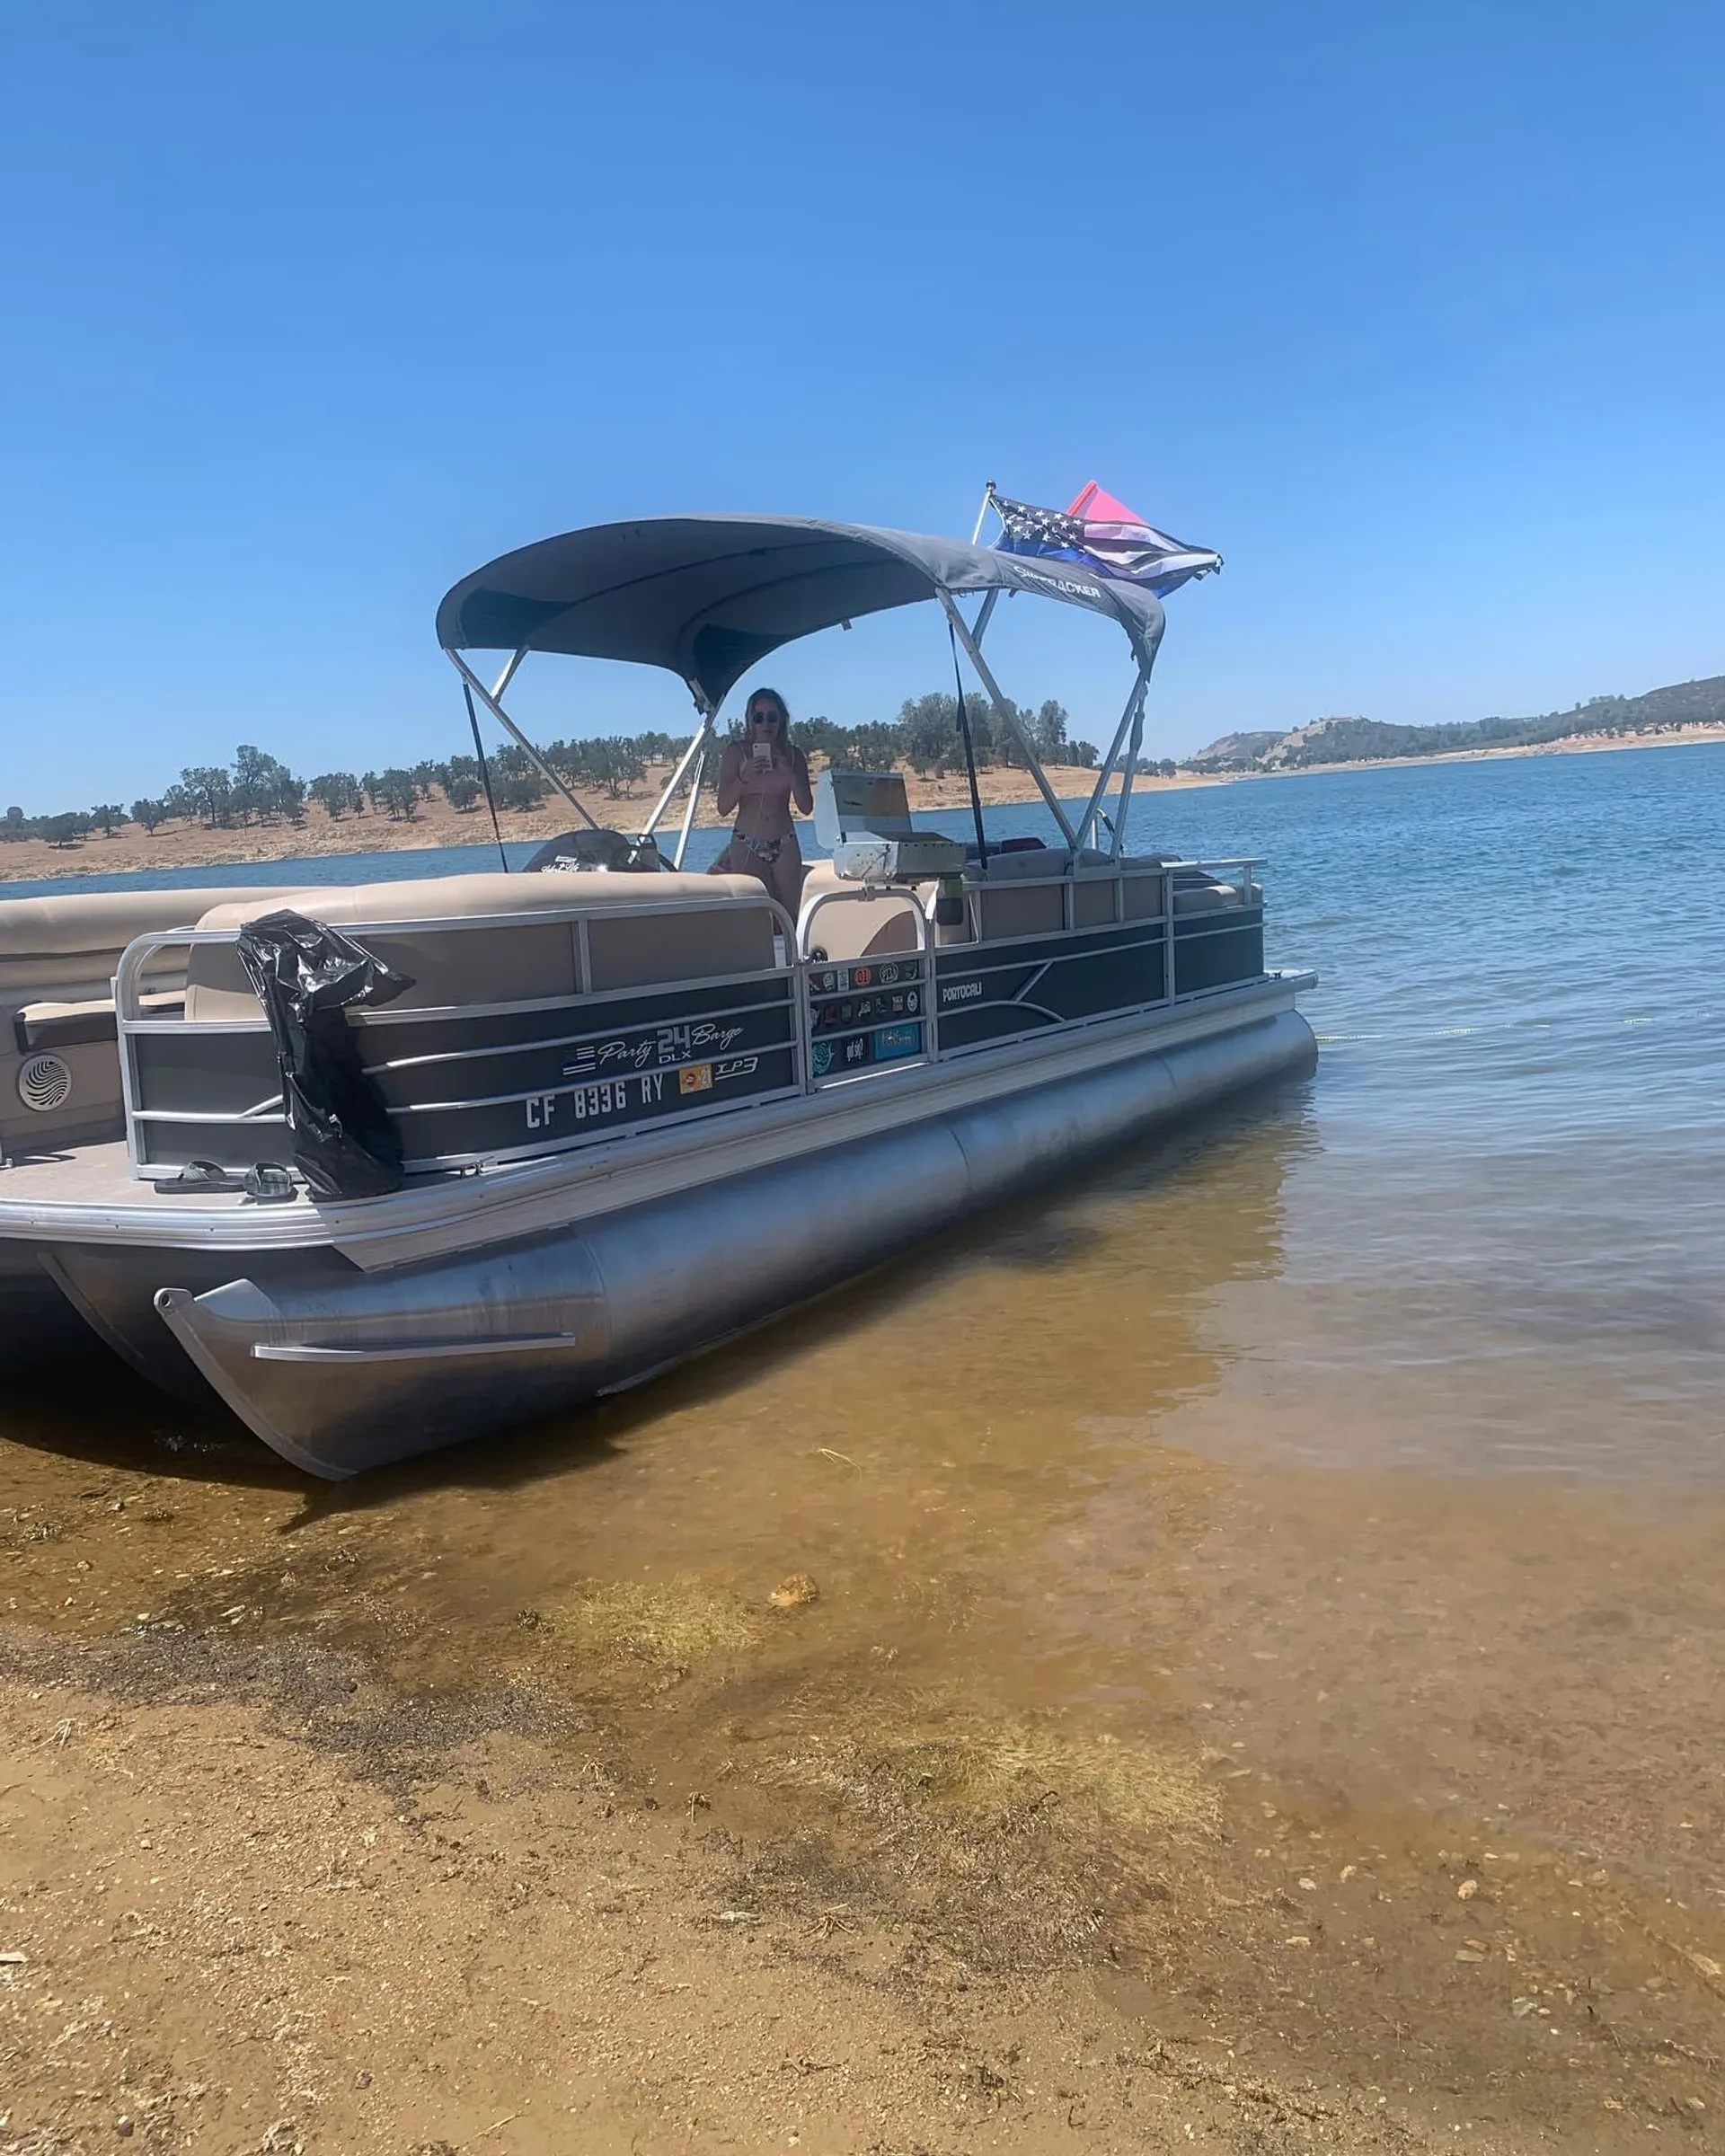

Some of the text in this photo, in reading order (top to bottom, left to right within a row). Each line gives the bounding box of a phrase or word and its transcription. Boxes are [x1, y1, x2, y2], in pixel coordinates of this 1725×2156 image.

[942, 981, 982, 1003] PORTOCALI
[597, 1023, 744, 1068] Party 24 Barge
[659, 1049, 692, 1065] DLX
[715, 1056, 759, 1077] XP3
[526, 1073, 664, 1129] CF 8336 RY
